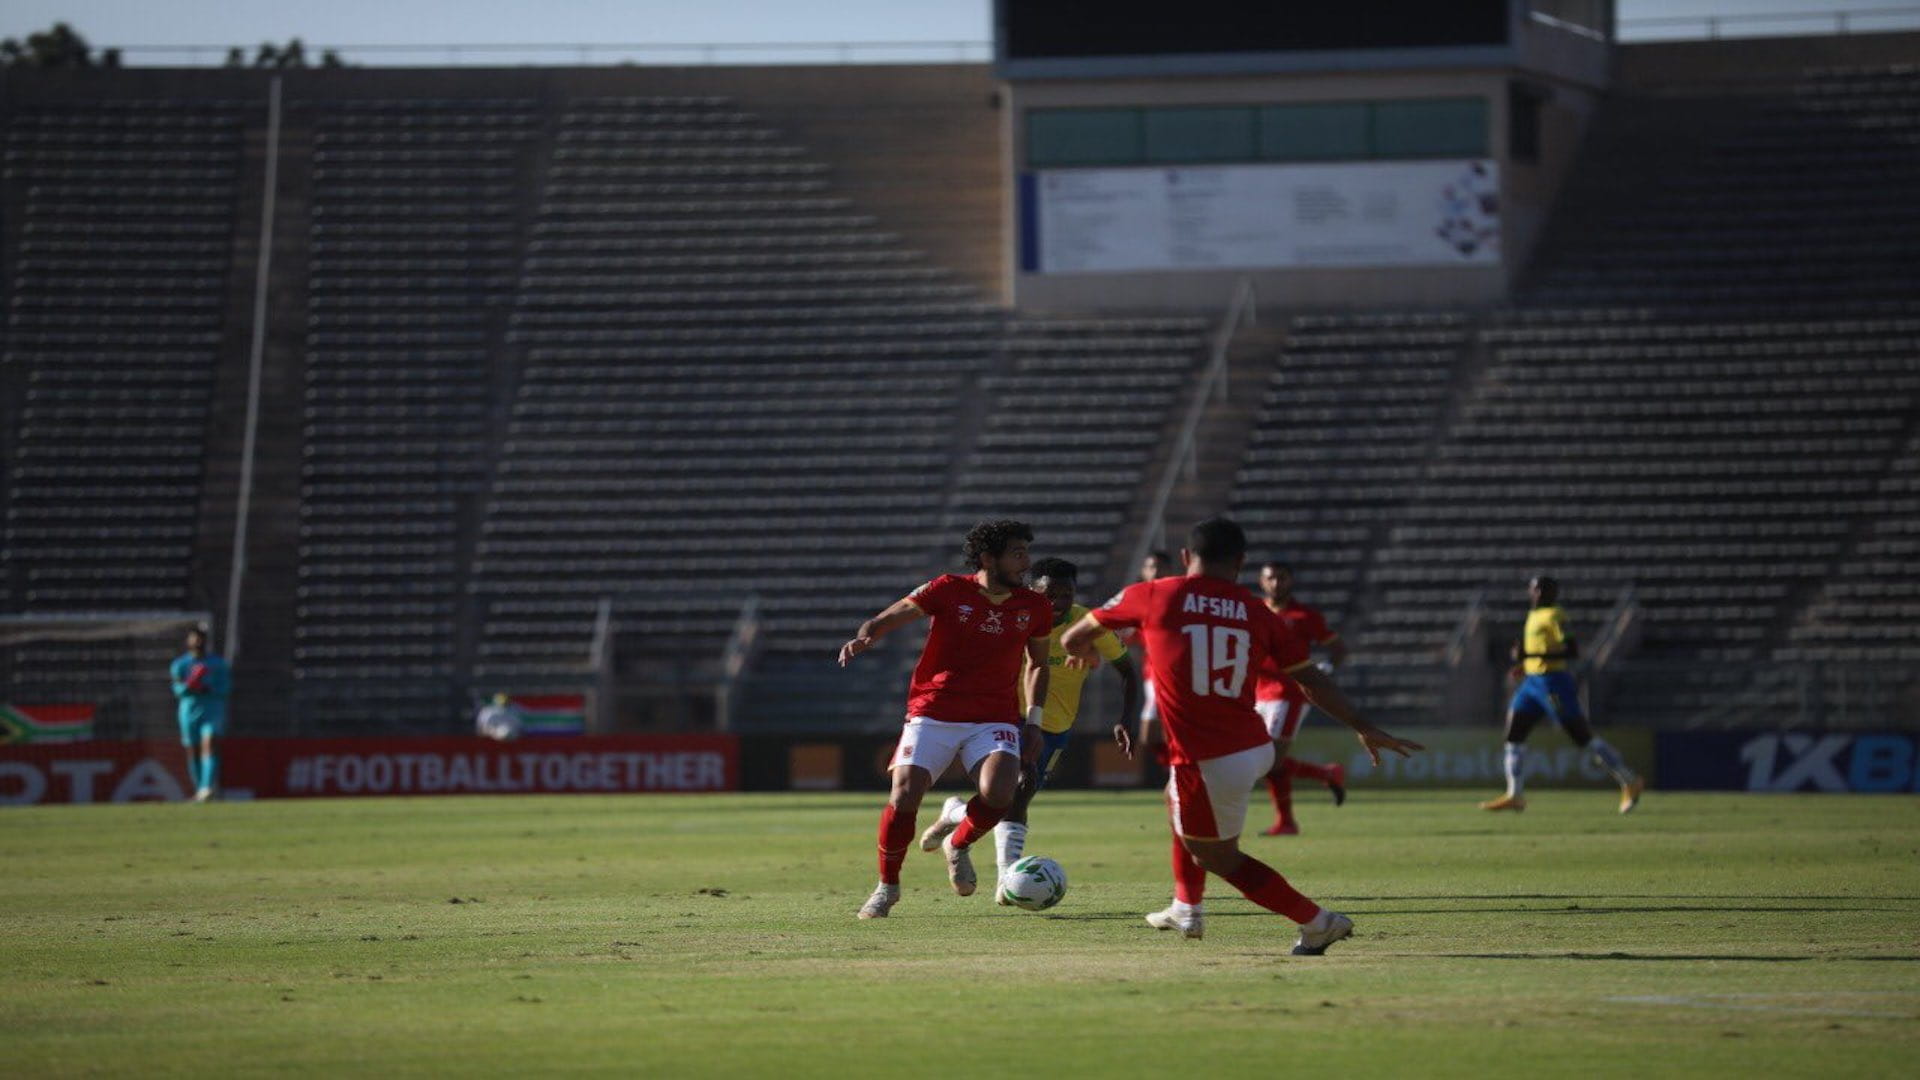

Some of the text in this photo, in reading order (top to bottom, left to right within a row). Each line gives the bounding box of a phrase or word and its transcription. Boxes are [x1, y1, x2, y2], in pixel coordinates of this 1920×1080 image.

[1183, 592, 1249, 622] AFSHA
[979, 623, 1005, 634] saib
[1181, 623, 1251, 699] 19
[286, 752, 725, 792] #FOOTBALLTOGETHER
[1740, 732, 1920, 792] 1XB
